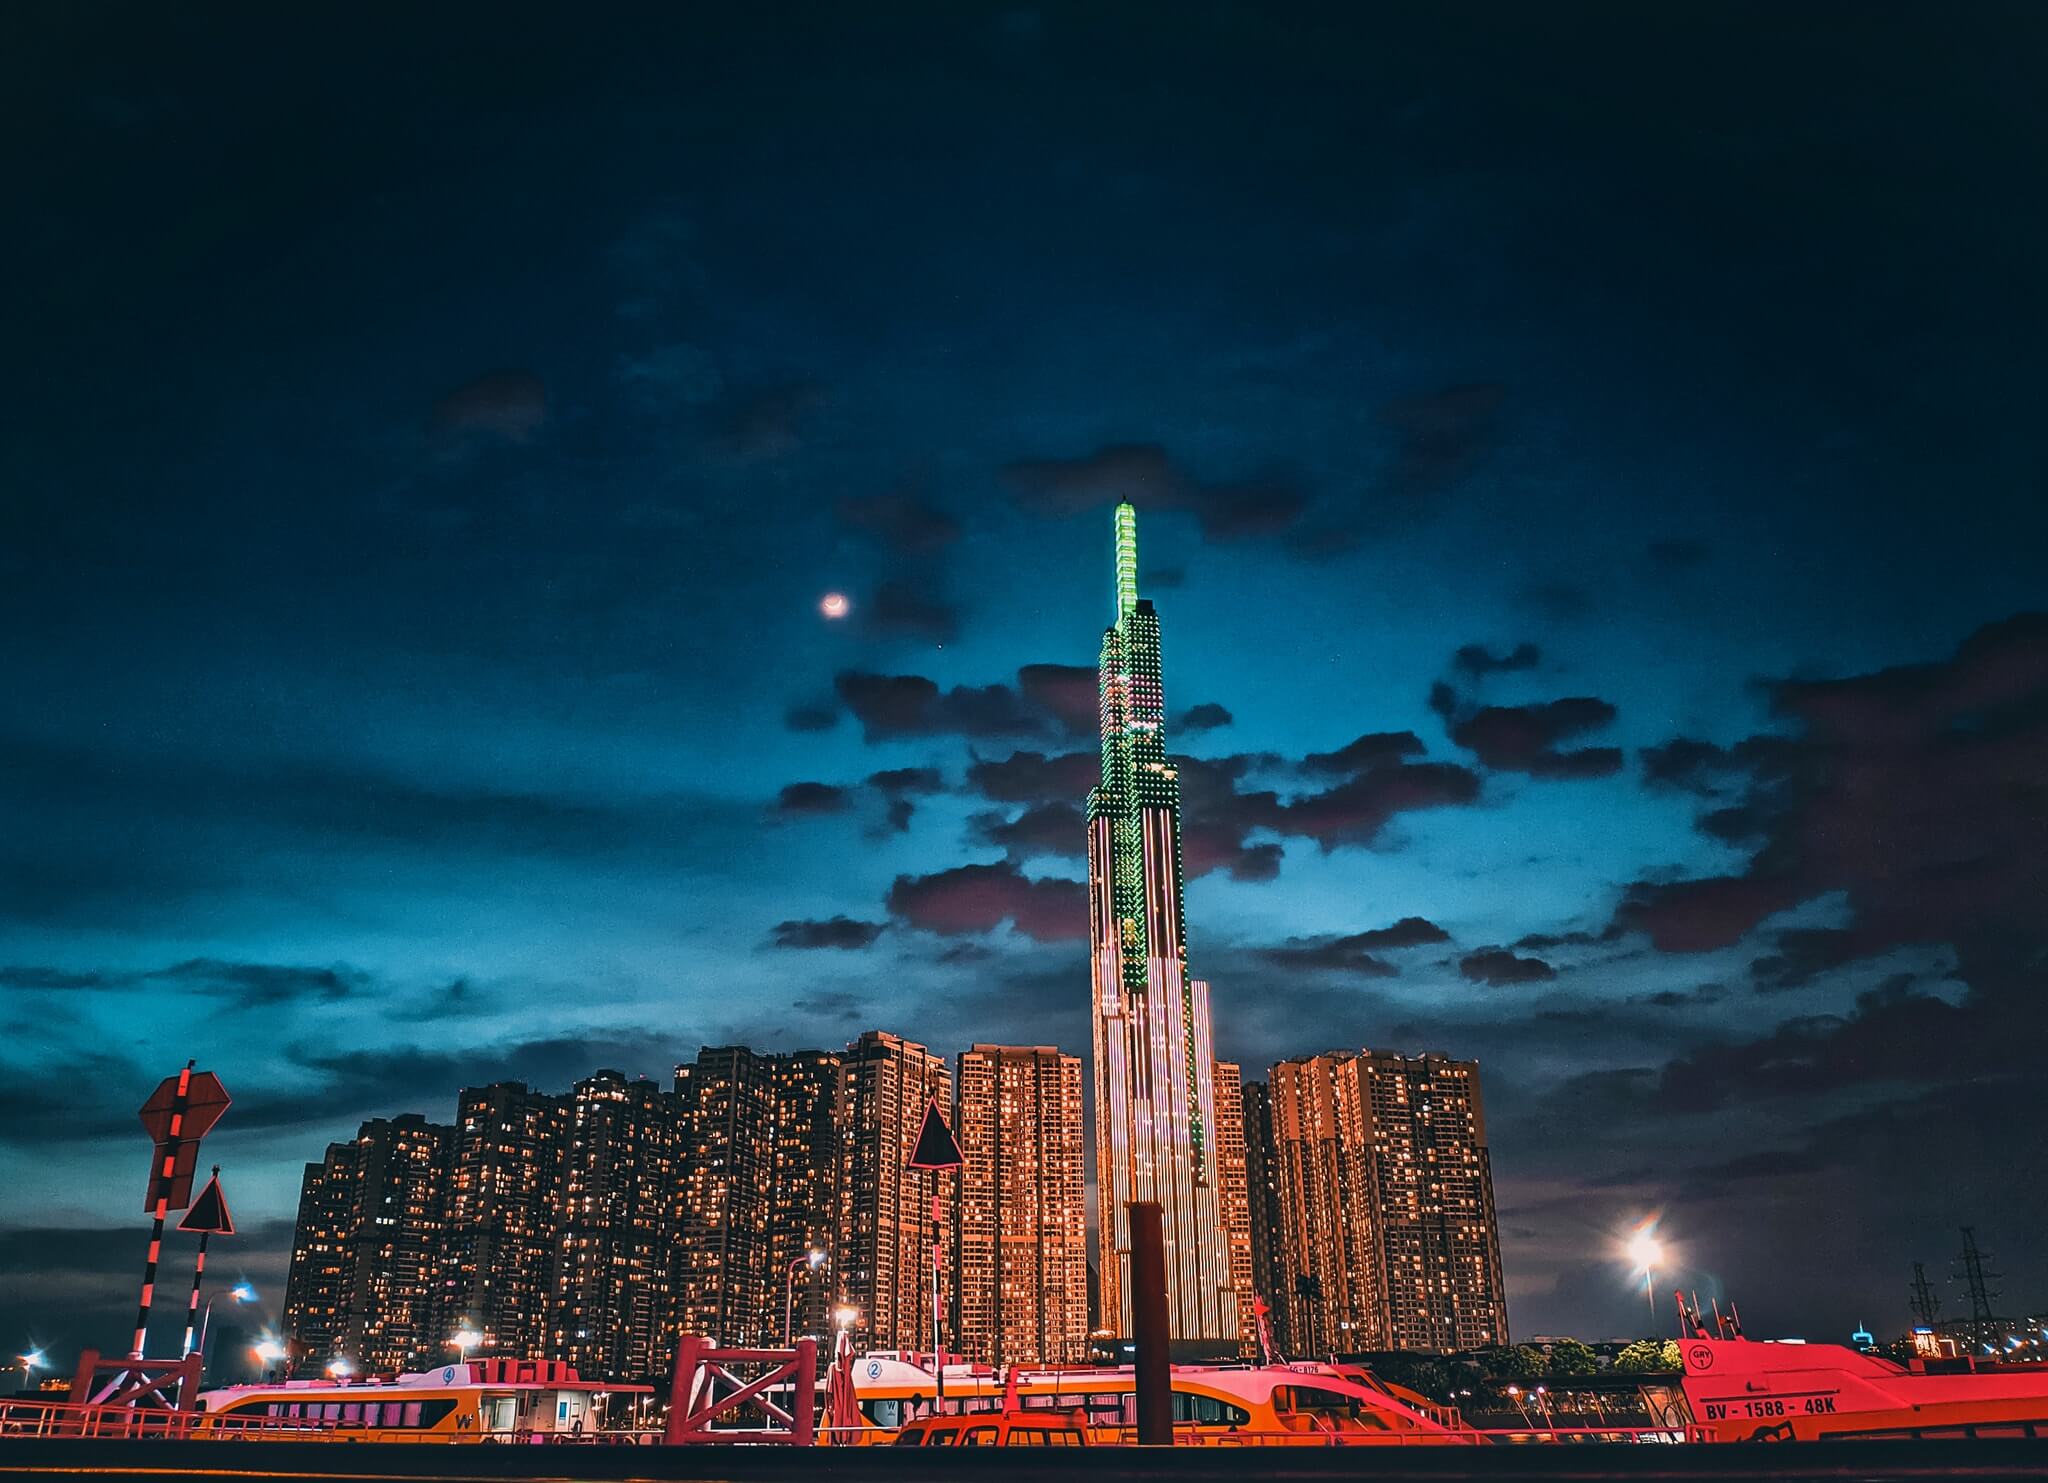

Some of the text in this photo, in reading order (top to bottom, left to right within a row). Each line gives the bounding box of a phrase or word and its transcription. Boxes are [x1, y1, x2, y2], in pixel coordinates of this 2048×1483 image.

[1700, 1359, 1704, 1367] 1
[871, 1364, 878, 1375] 2
[1706, 1404, 1727, 1420] BV
[1744, 1401, 1784, 1417] 1588
[1804, 1398, 1836, 1414] 48K
